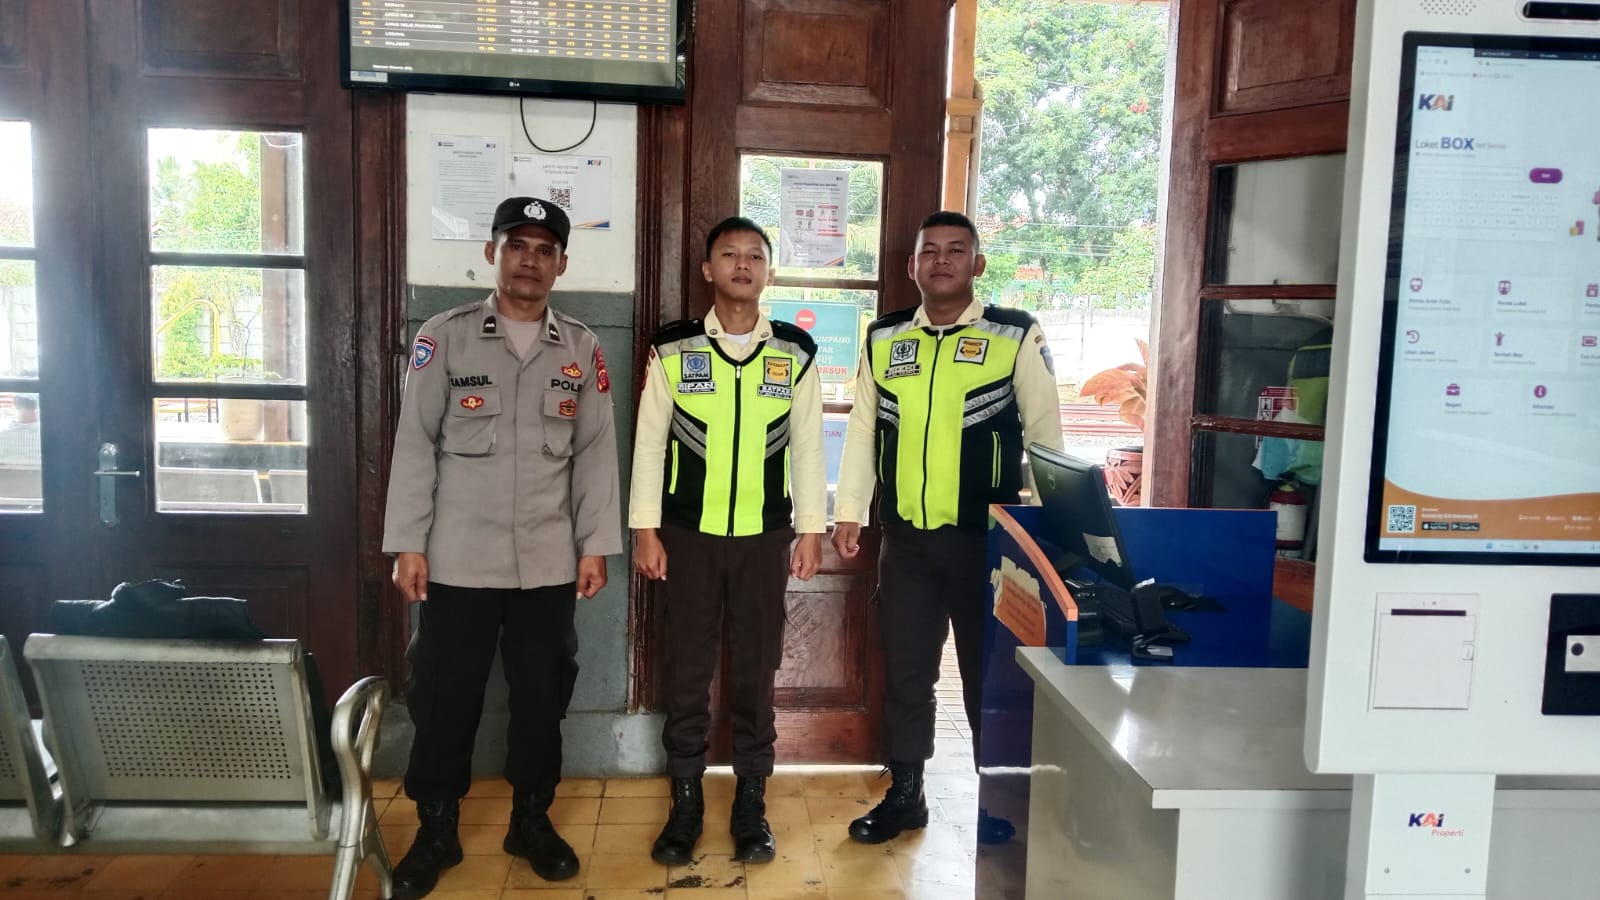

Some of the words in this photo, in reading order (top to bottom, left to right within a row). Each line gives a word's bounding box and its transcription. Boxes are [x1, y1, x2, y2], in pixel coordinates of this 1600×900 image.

[1440, 137, 1474, 150] BOX
[815, 336, 851, 344] UMPANG
[816, 355, 833, 364] PUT
[450, 375, 493, 388] AMSUL
[824, 430, 842, 438] TIAN
[1431, 829, 1464, 838] Properti
